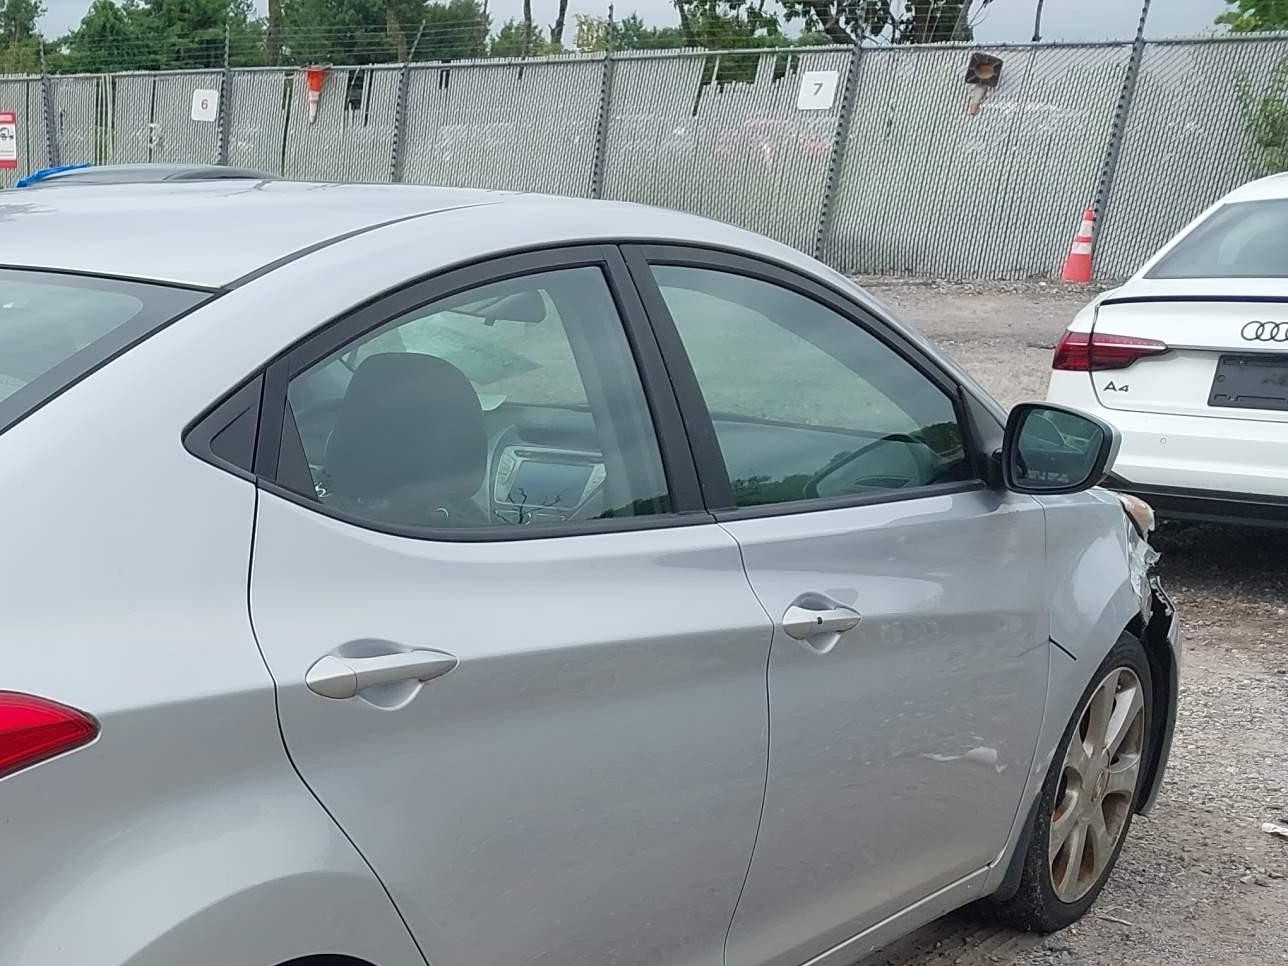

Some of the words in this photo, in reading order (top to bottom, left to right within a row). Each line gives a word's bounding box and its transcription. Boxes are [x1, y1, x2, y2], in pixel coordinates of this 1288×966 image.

[813, 82, 824, 96] 7
[201, 98, 209, 111] 6
[1103, 380, 1130, 393] A4
